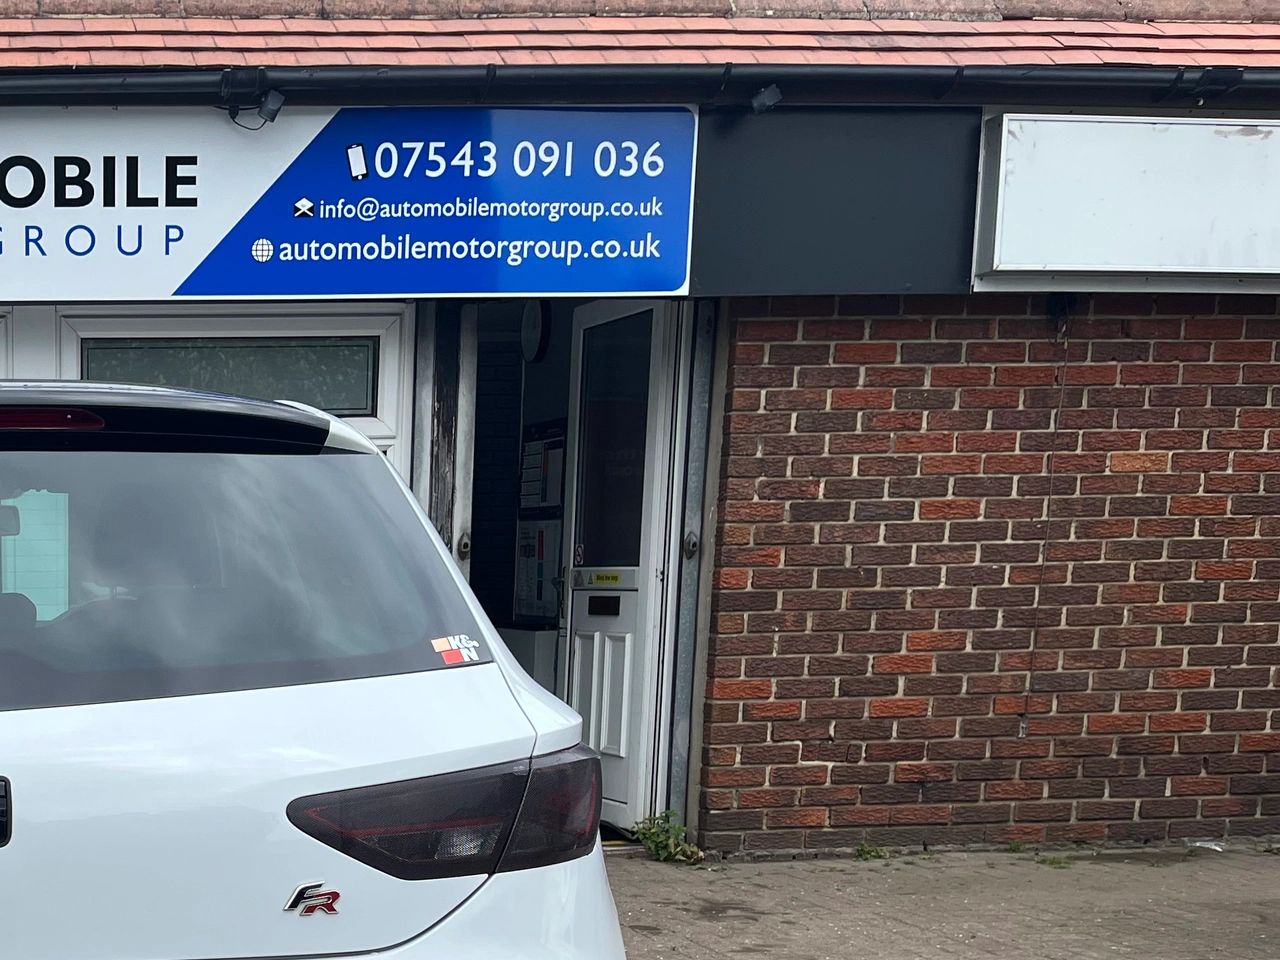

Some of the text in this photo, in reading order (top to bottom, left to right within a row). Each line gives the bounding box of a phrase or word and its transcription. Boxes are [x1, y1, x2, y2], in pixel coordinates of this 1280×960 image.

[374, 140, 665, 179] 07543 091 036
[319, 197, 663, 222] info@automobilemotorgroup.co.uk
[278, 233, 661, 266] automobilemotorgroup.co.uk
